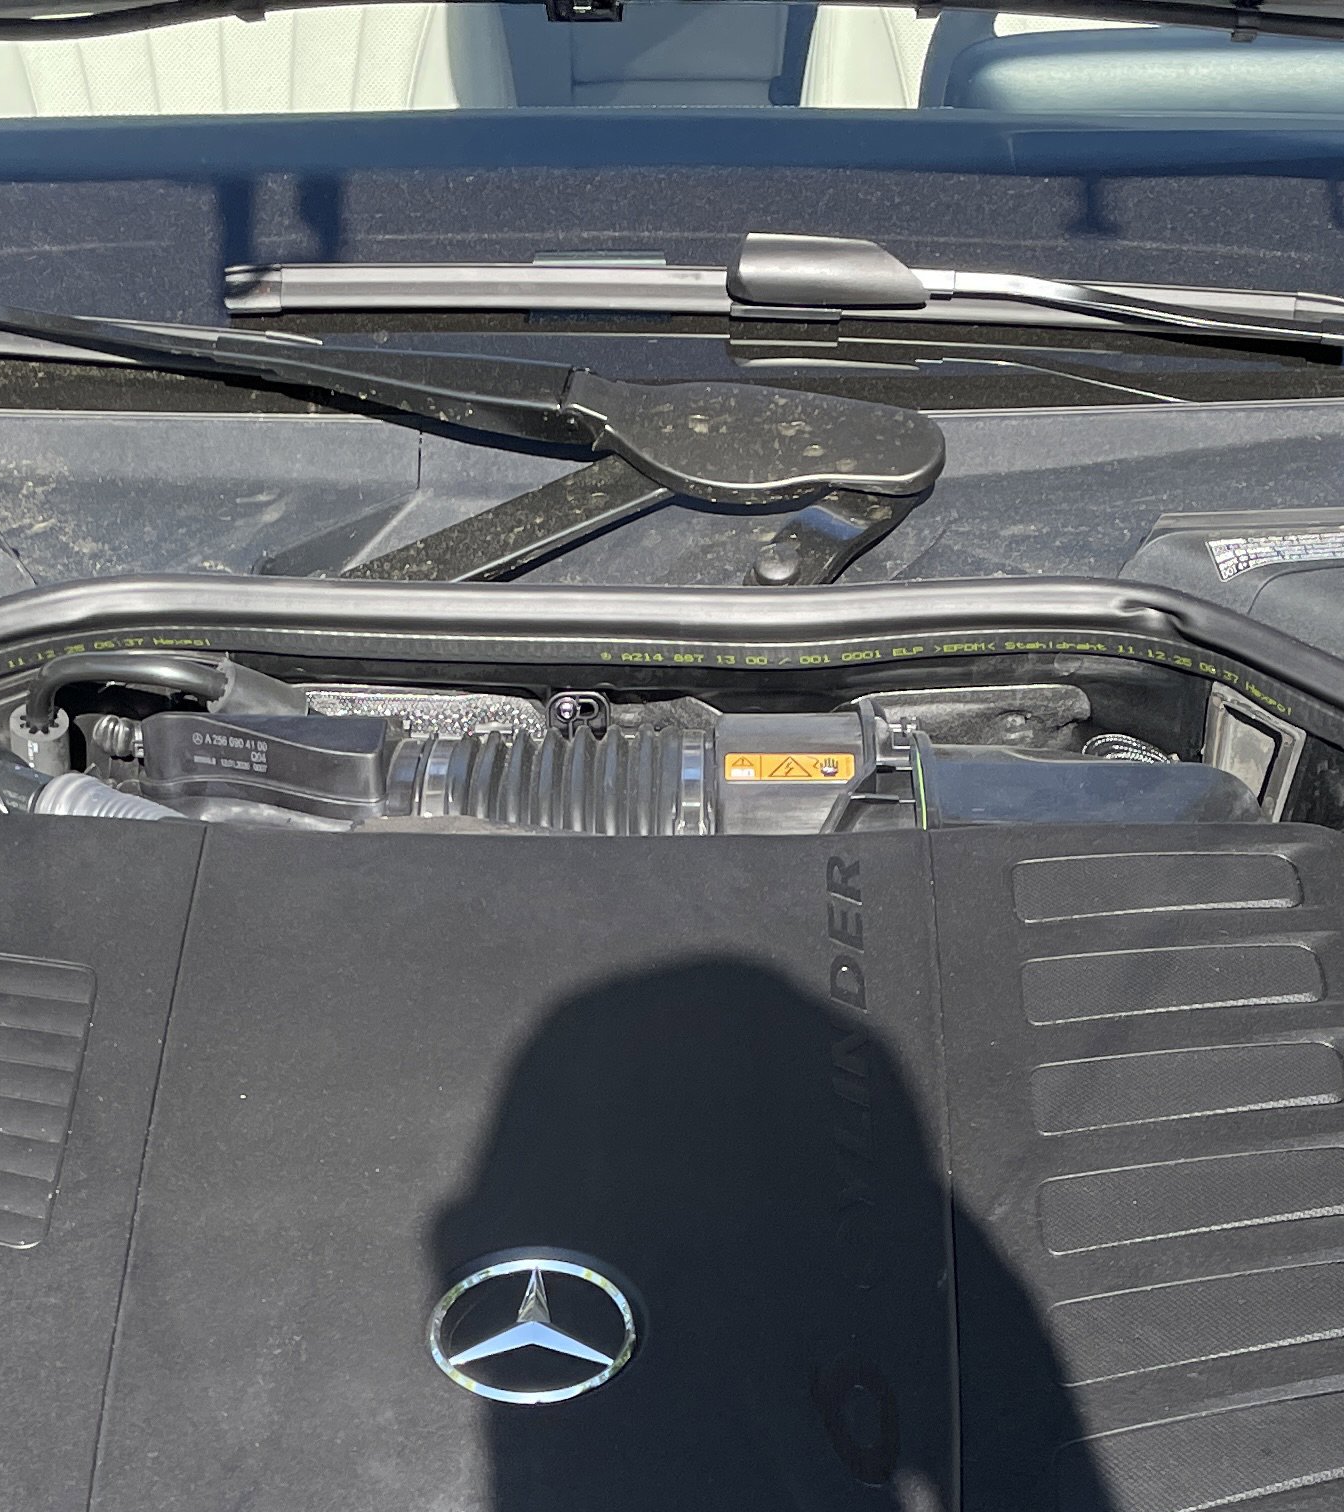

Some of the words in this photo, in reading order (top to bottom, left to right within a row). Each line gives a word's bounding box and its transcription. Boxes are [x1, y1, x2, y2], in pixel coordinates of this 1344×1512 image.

[621, 652, 664, 663] A214
[716, 654, 736, 665] 13
[745, 655, 768, 666] 00
[799, 654, 831, 665] 001
[892, 645, 924, 657] ELP
[1004, 640, 1107, 651] Stahldraht
[245, 739, 256, 750] 41
[257, 740, 268, 752] 00
